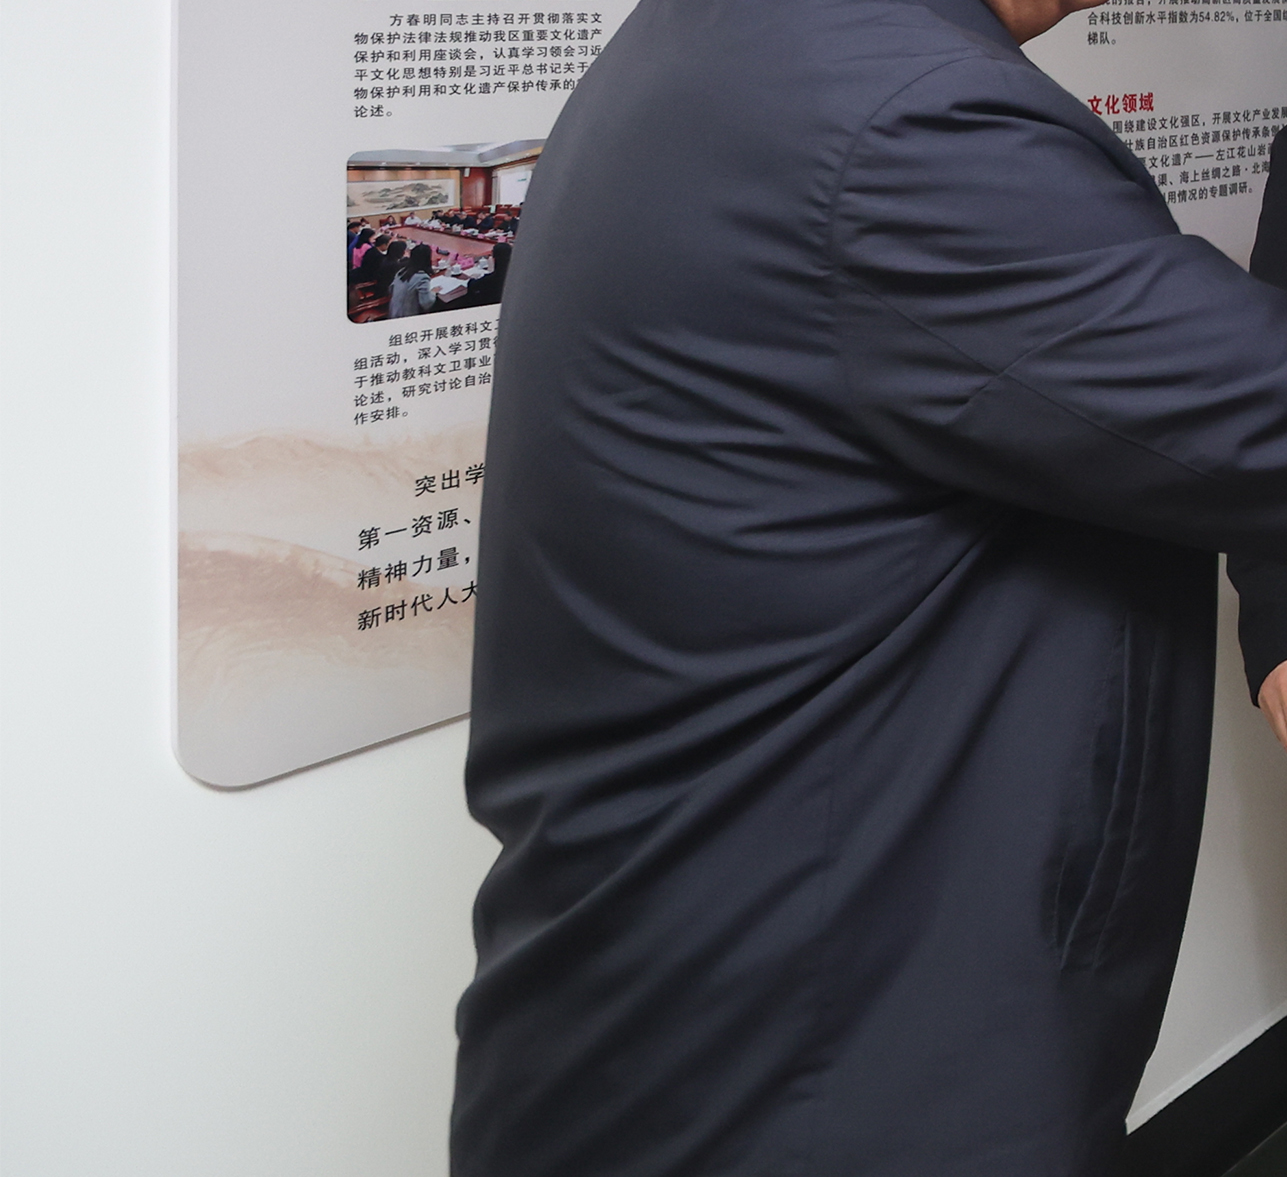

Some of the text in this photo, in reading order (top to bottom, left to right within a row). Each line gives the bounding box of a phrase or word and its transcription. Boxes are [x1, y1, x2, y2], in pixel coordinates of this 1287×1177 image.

[390, 11, 602, 27] 方春明同志主持召开贯彻落实文
[354, 28, 602, 45] 物保护法律法规推动我区重要文化遗产
[1087, 31, 1117, 46] 梯队。
[354, 45, 602, 64] 保护和利用座谈会，认真学习领会习近
[354, 62, 588, 82] 平文化思想特别是习近平总书记关于
[354, 78, 581, 100] 物保护利用和文化遗产保护传承的
[354, 104, 393, 118] 论述。
[1088, 92, 1154, 115] 文化领域
[1152, 160, 1270, 187] 渠、海上丝绸之路·北海
[1163, 181, 1252, 204] 用情况的专题调研。
[353, 353, 496, 389] 于推动教科文卫事业
[353, 372, 492, 407] 论述，研究讨论自治
[353, 406, 409, 425] 作安排。
[415, 462, 485, 497] 突出学
[358, 507, 471, 551] 第一资源、
[357, 546, 470, 591] 精神力量，
